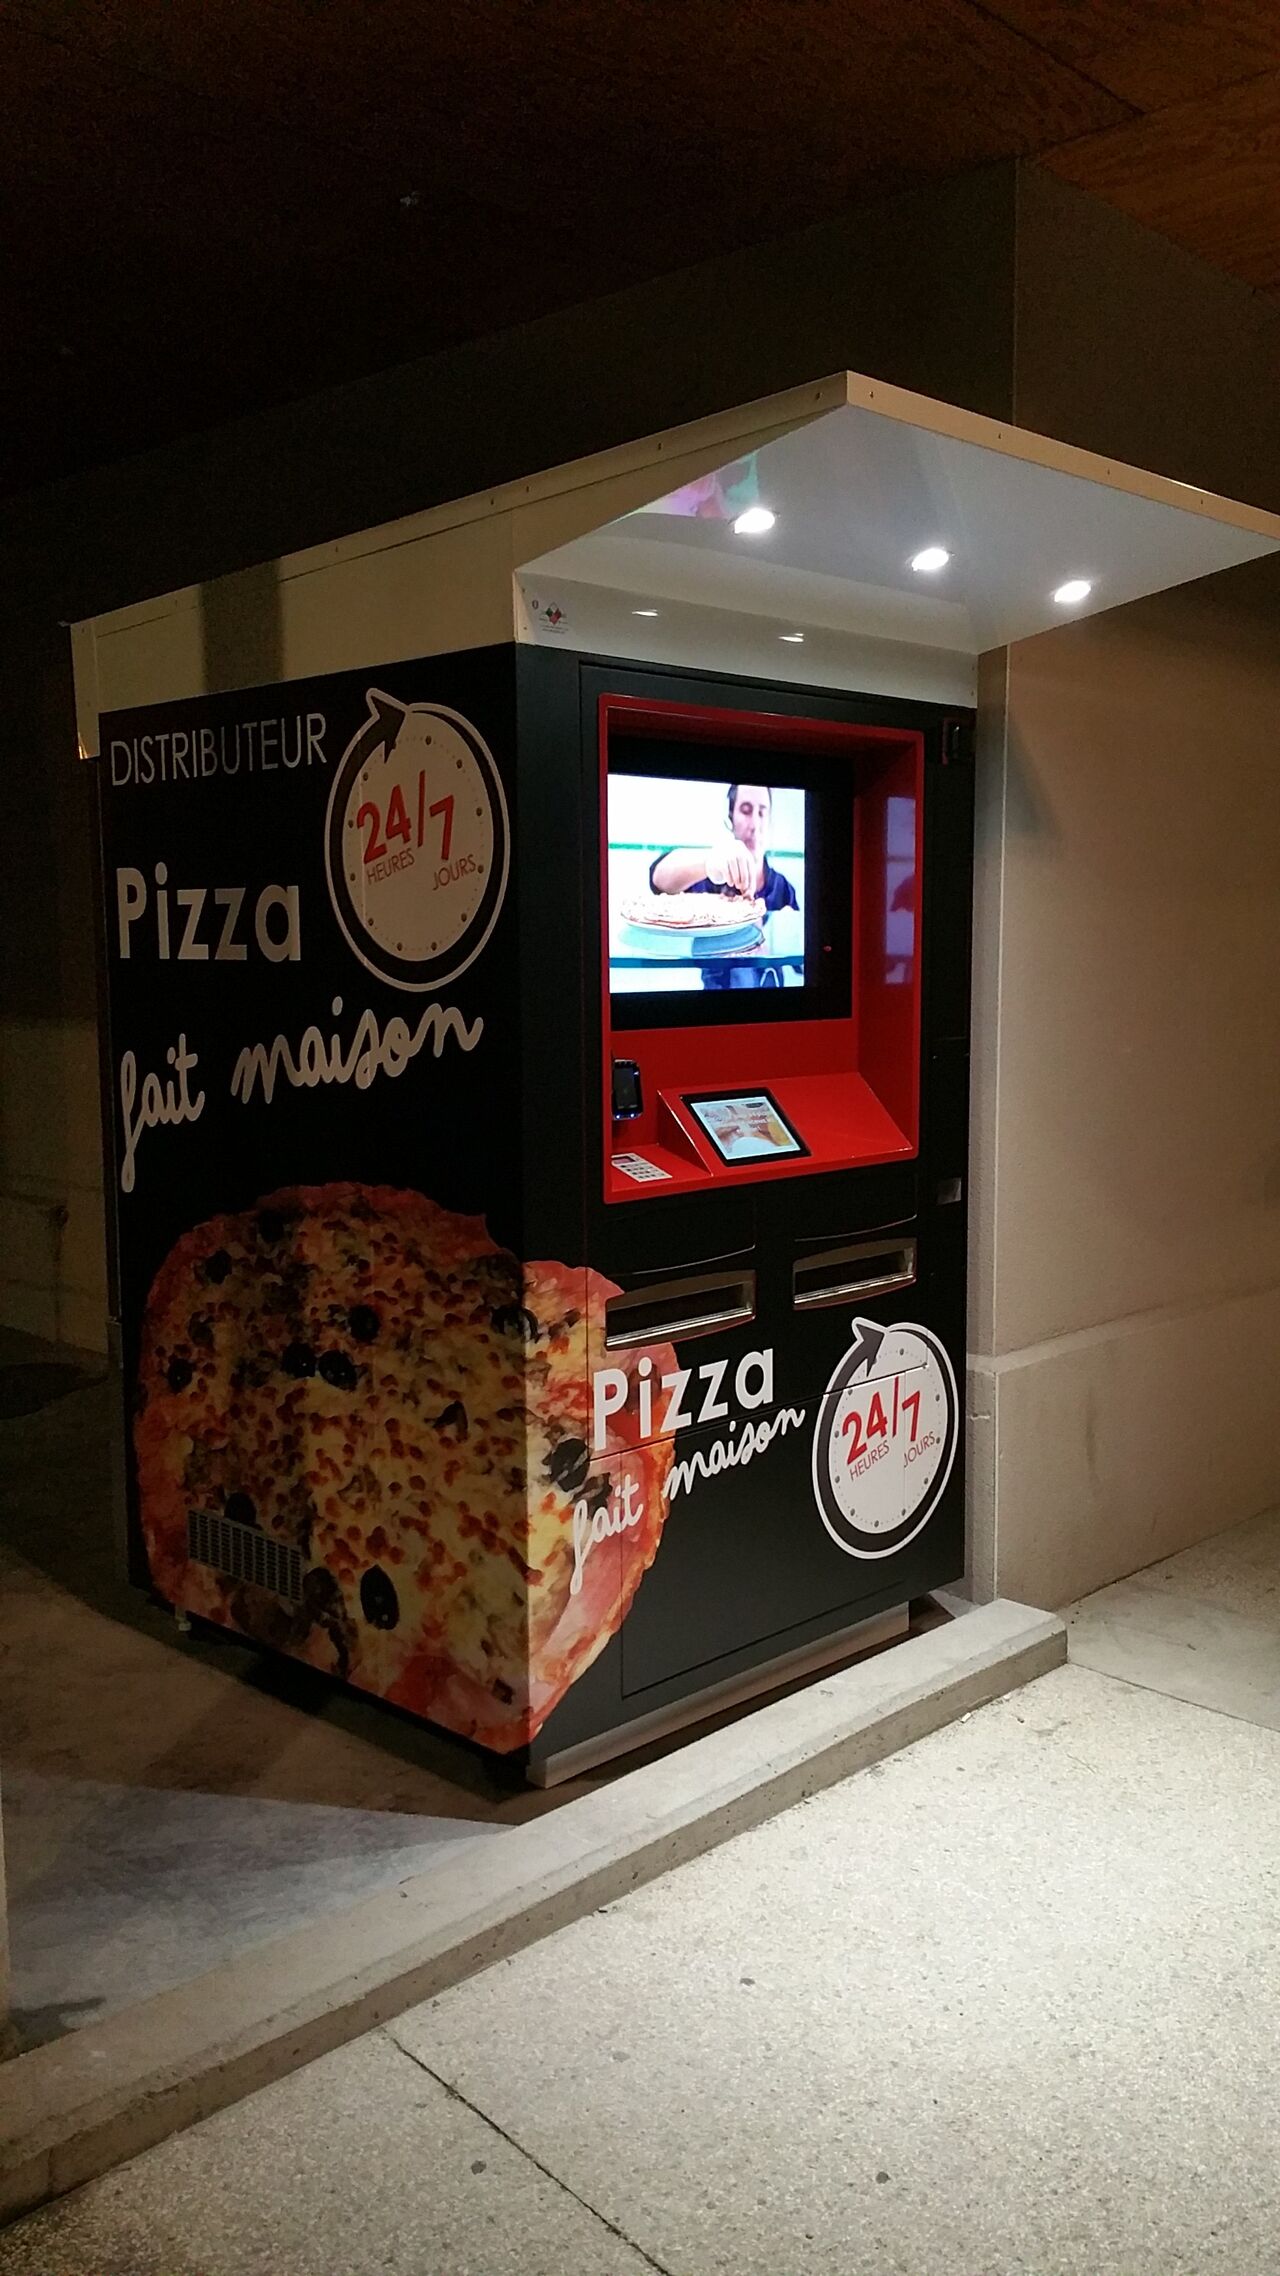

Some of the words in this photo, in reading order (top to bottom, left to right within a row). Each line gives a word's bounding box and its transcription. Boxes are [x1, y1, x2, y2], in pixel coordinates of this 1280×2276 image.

[110, 712, 328, 787] DISTRIBUTEUR
[356, 770, 456, 866] 24/7
[115, 862, 301, 962] Pizza
[366, 847, 415, 886] HEURES
[432, 854, 477, 891] JOURS
[120, 1033, 206, 1193] fait
[230, 996, 484, 1104] maison
[592, 1348, 774, 1451] Pizza
[841, 1376, 921, 1465] 24/7
[569, 1474, 644, 1595] fait
[662, 1407, 806, 1500] maison
[849, 1439, 891, 1482] HEURES
[903, 1431, 936, 1470] JOURS
